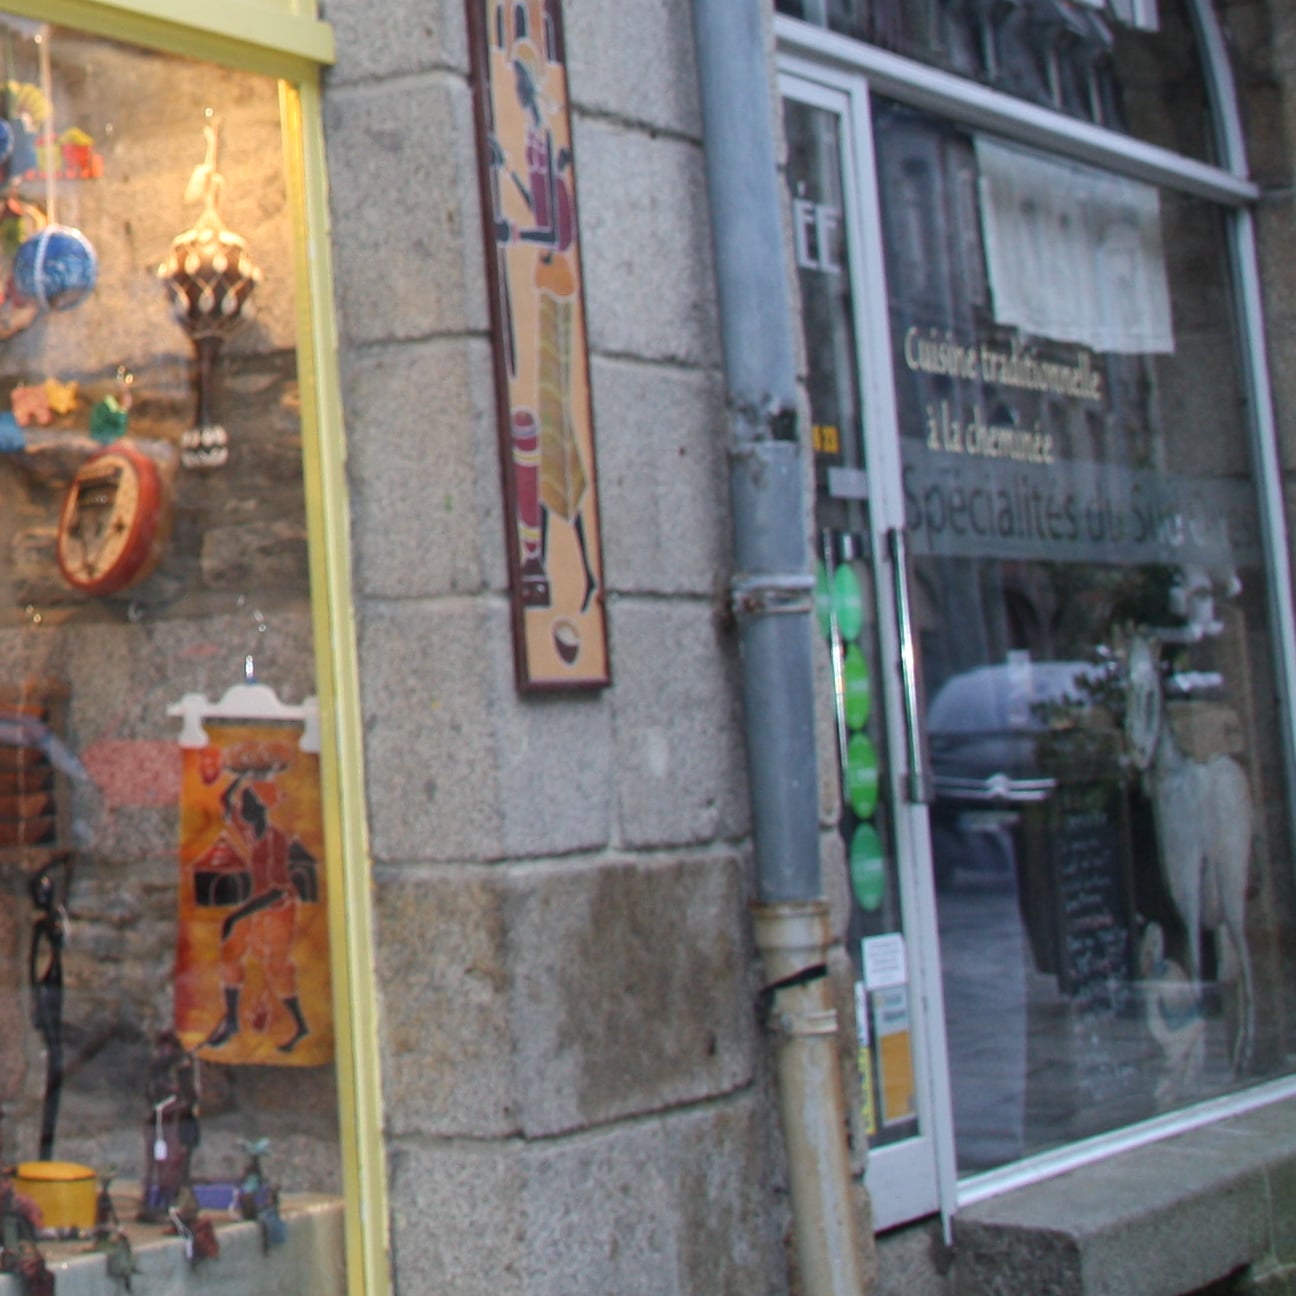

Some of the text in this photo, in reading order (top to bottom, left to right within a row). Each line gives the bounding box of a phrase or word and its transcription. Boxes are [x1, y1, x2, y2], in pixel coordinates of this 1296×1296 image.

[904, 325, 1103, 401] Cuisine traditionnelle
[942, 400, 964, 454] la
